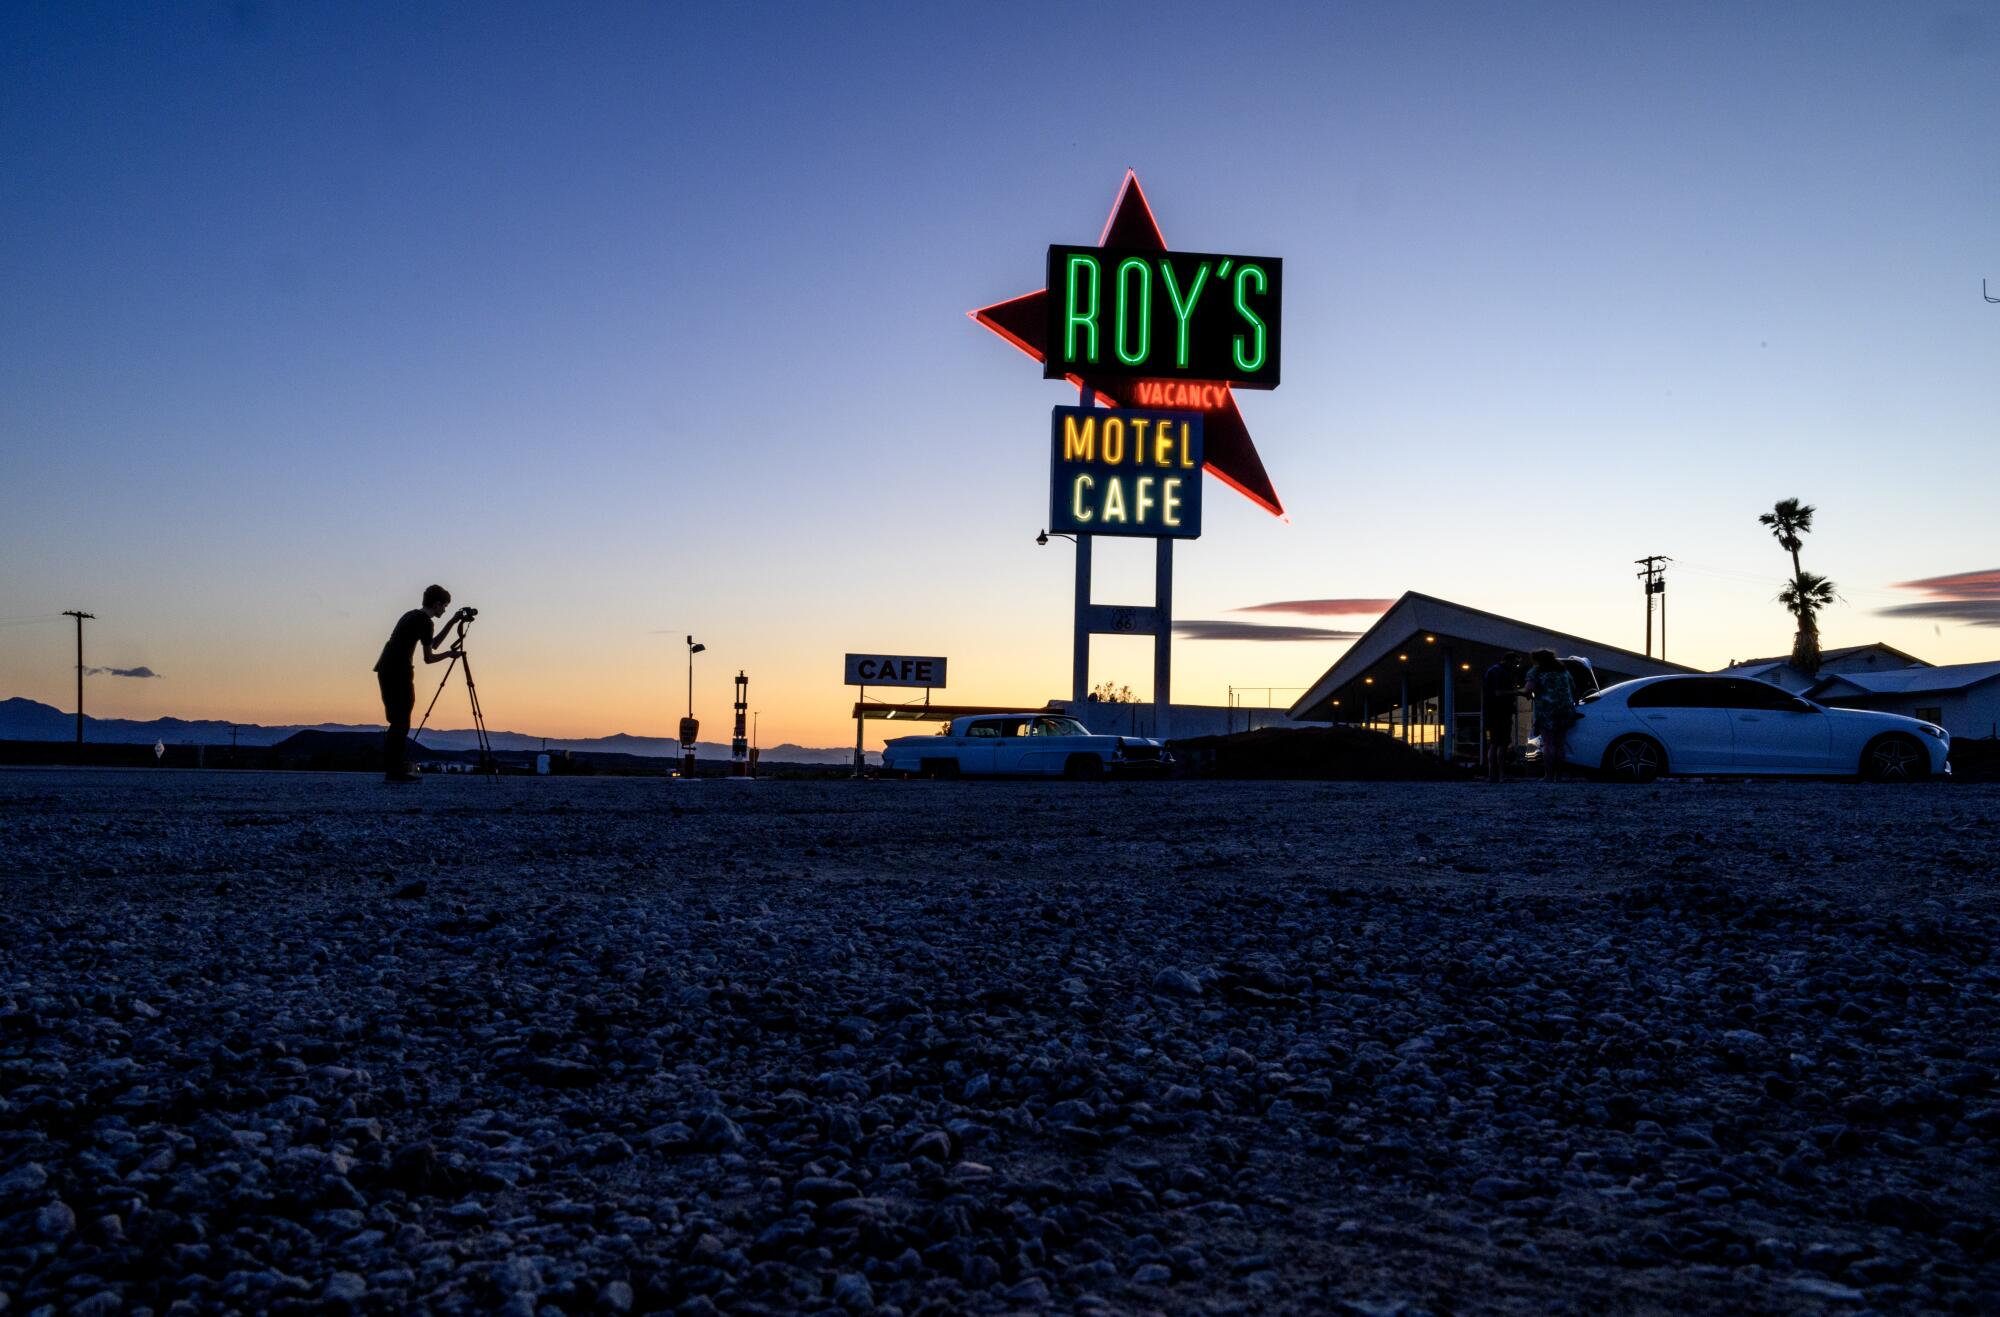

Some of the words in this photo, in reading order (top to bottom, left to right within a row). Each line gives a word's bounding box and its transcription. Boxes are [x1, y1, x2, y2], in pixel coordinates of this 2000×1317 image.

[1064, 253, 1268, 373] ROY'S
[1139, 382, 1227, 409] VACANCY
[1064, 415, 1195, 468] MOTEL
[1072, 473, 1183, 526] CAFE
[1116, 618, 1131, 629] 66
[858, 660, 932, 681] CAFE
